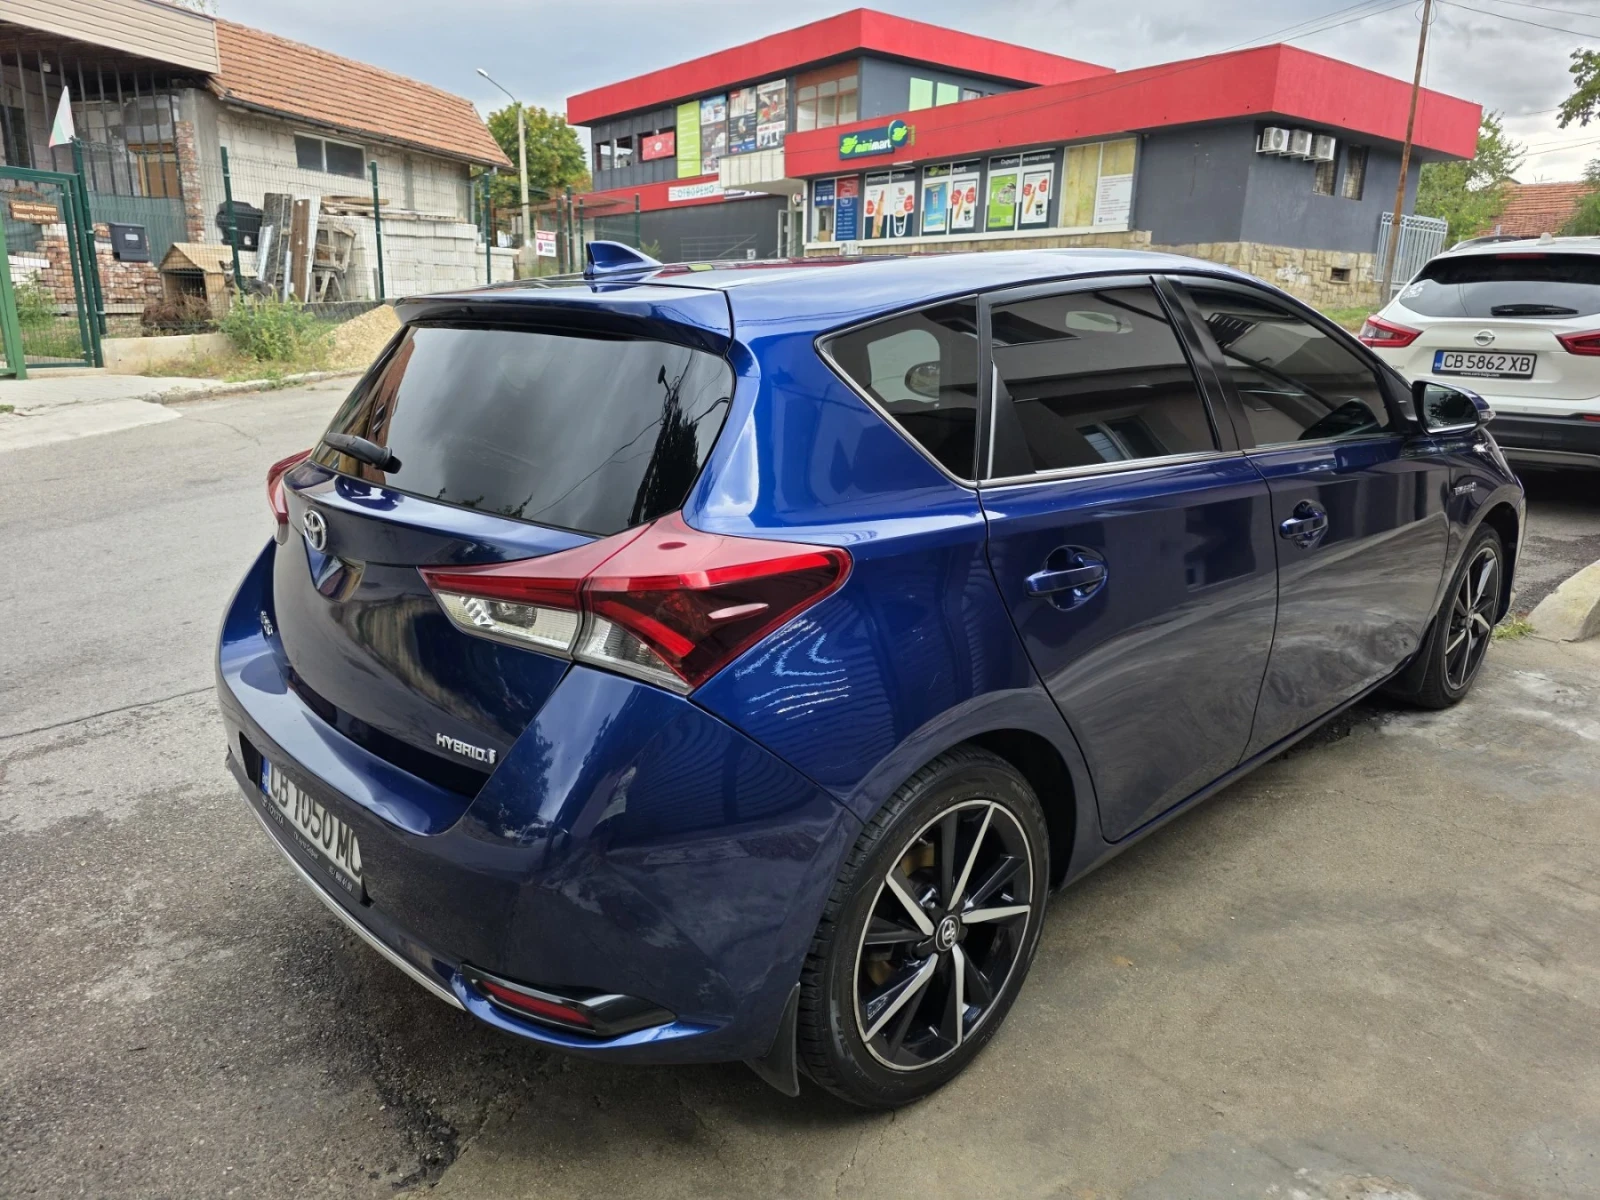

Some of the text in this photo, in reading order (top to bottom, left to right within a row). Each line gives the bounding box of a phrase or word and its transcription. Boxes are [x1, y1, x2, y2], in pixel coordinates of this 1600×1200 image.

[854, 138, 892, 153] minimart
[1444, 354, 1531, 372] CB 5862 XB
